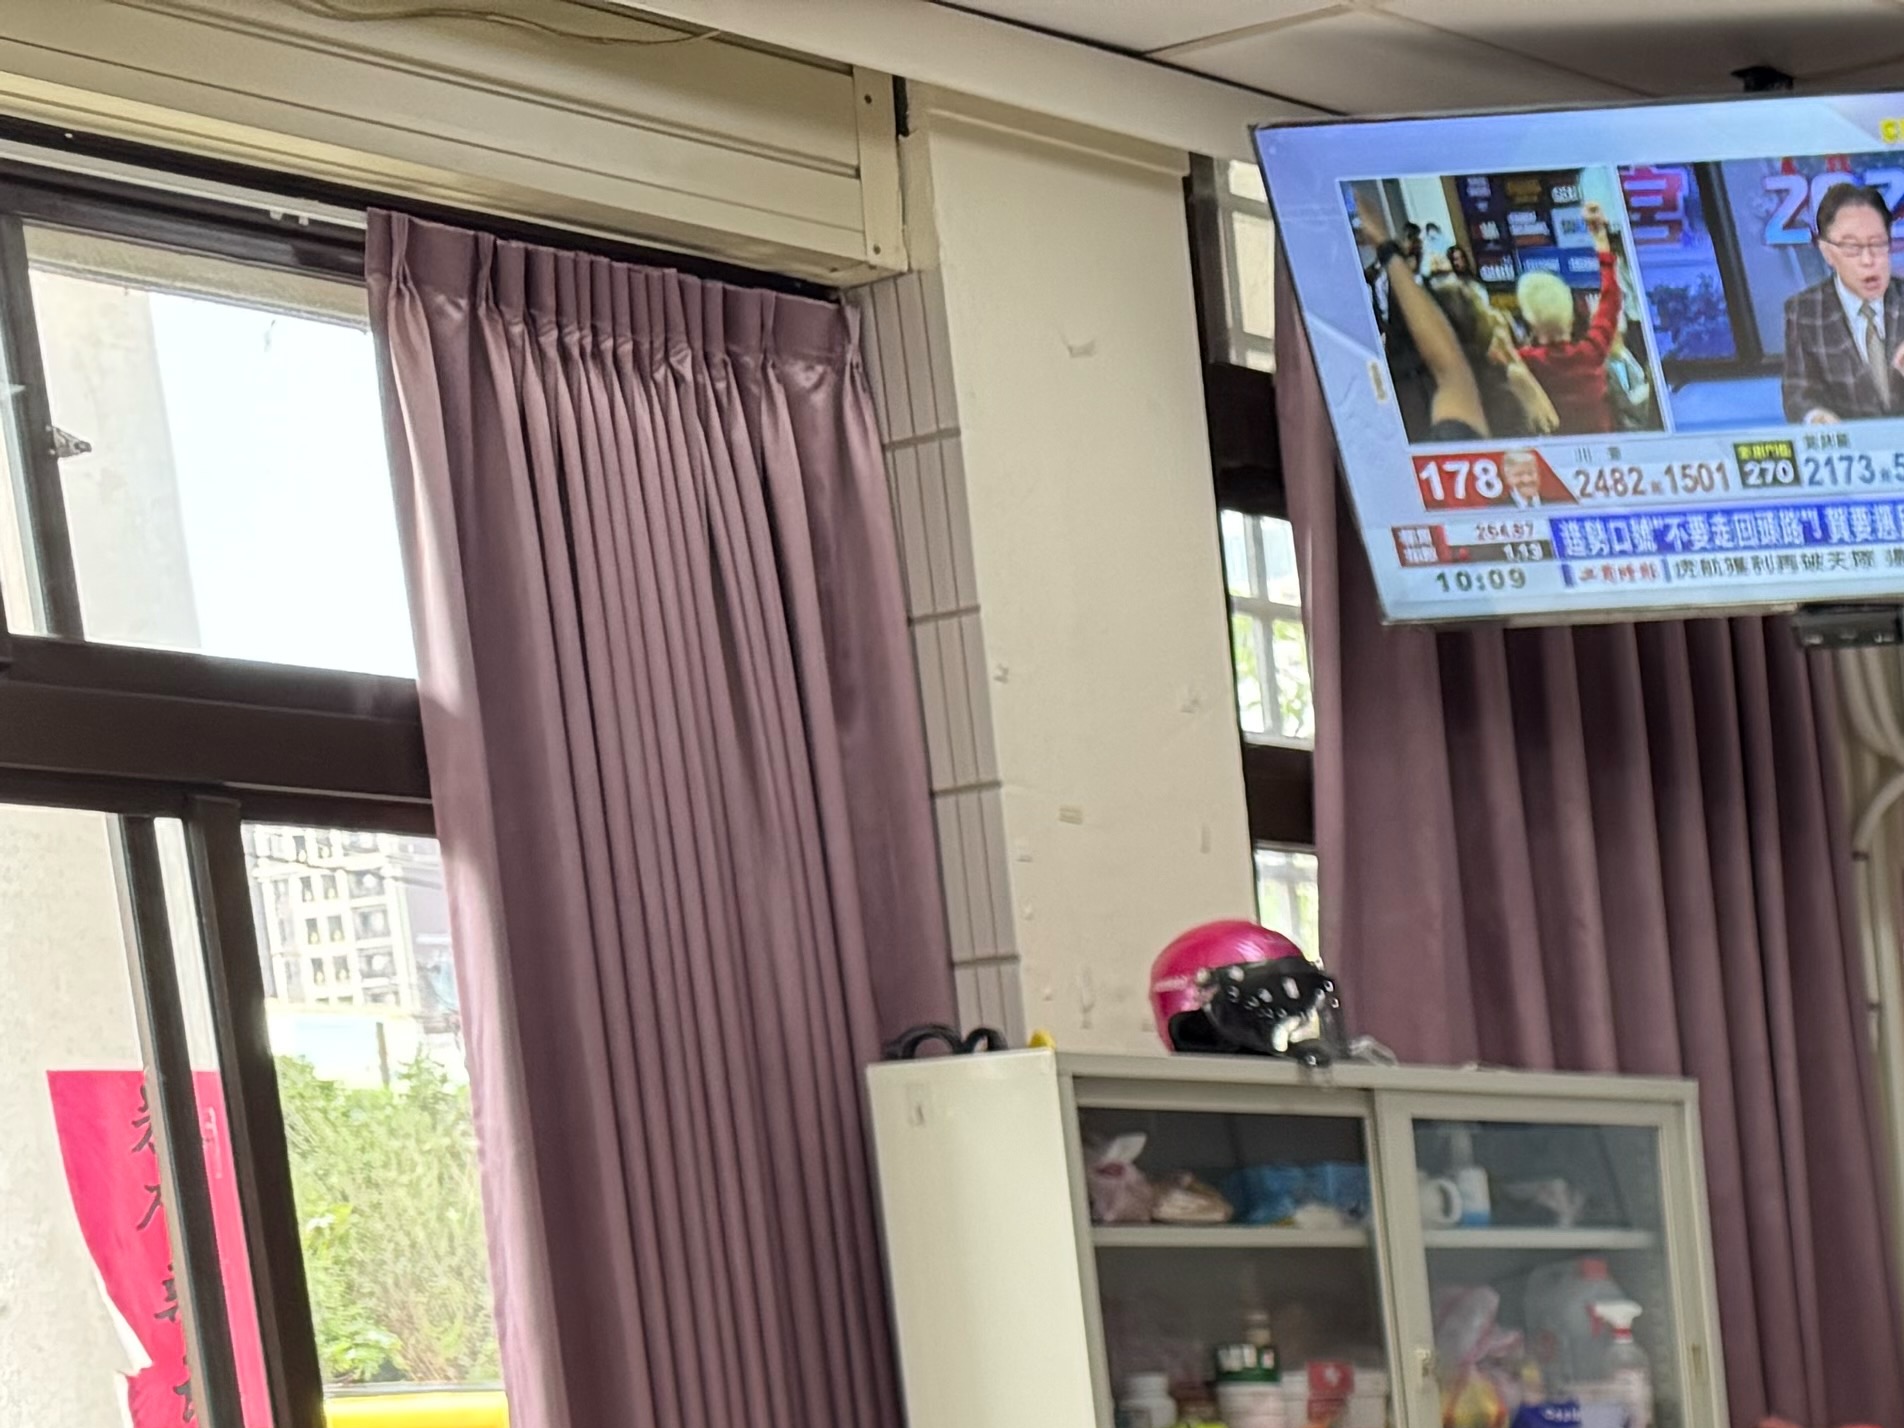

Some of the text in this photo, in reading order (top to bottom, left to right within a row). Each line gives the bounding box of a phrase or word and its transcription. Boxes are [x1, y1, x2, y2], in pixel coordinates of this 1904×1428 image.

[1419, 460, 1502, 501] 178
[1744, 460, 1795, 486] 270
[1436, 566, 1527, 592] 10:09
